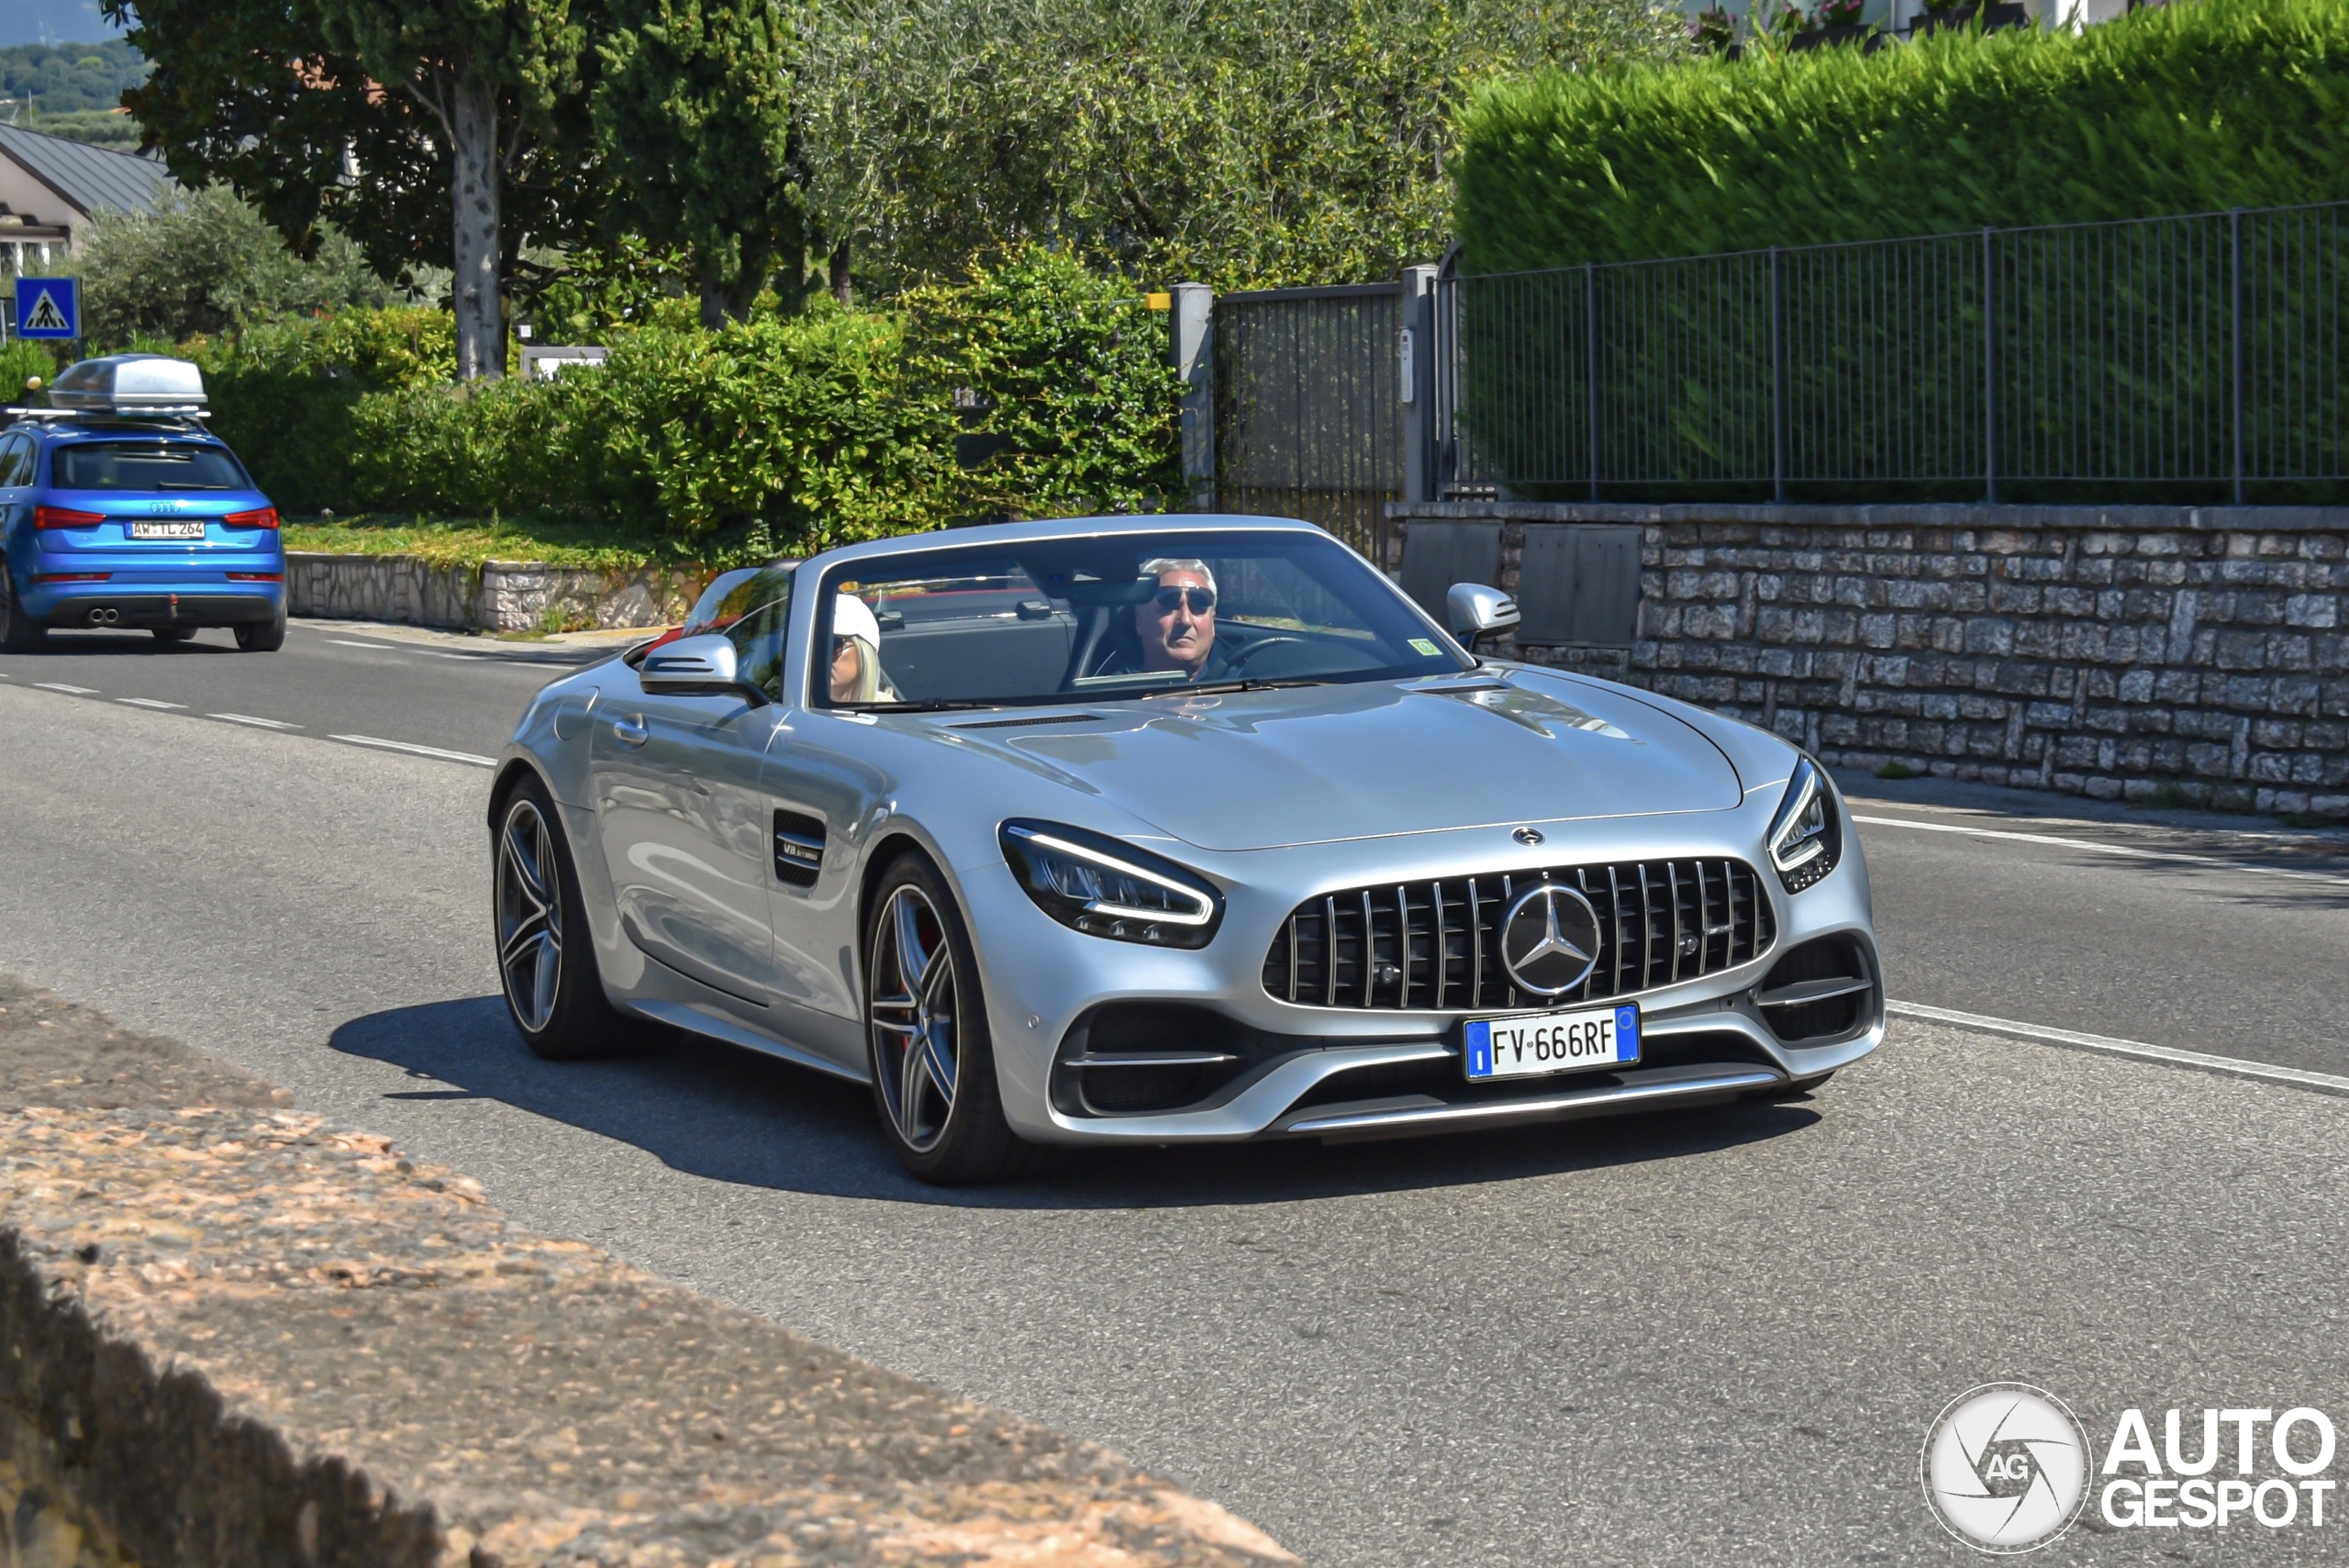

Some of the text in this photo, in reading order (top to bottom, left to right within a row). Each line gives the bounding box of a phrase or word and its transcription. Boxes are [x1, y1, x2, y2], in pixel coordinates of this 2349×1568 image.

[134, 523, 150, 535] AW
[159, 523, 175, 535] TL
[179, 523, 203, 535] 264
[784, 843, 796, 855] V8
